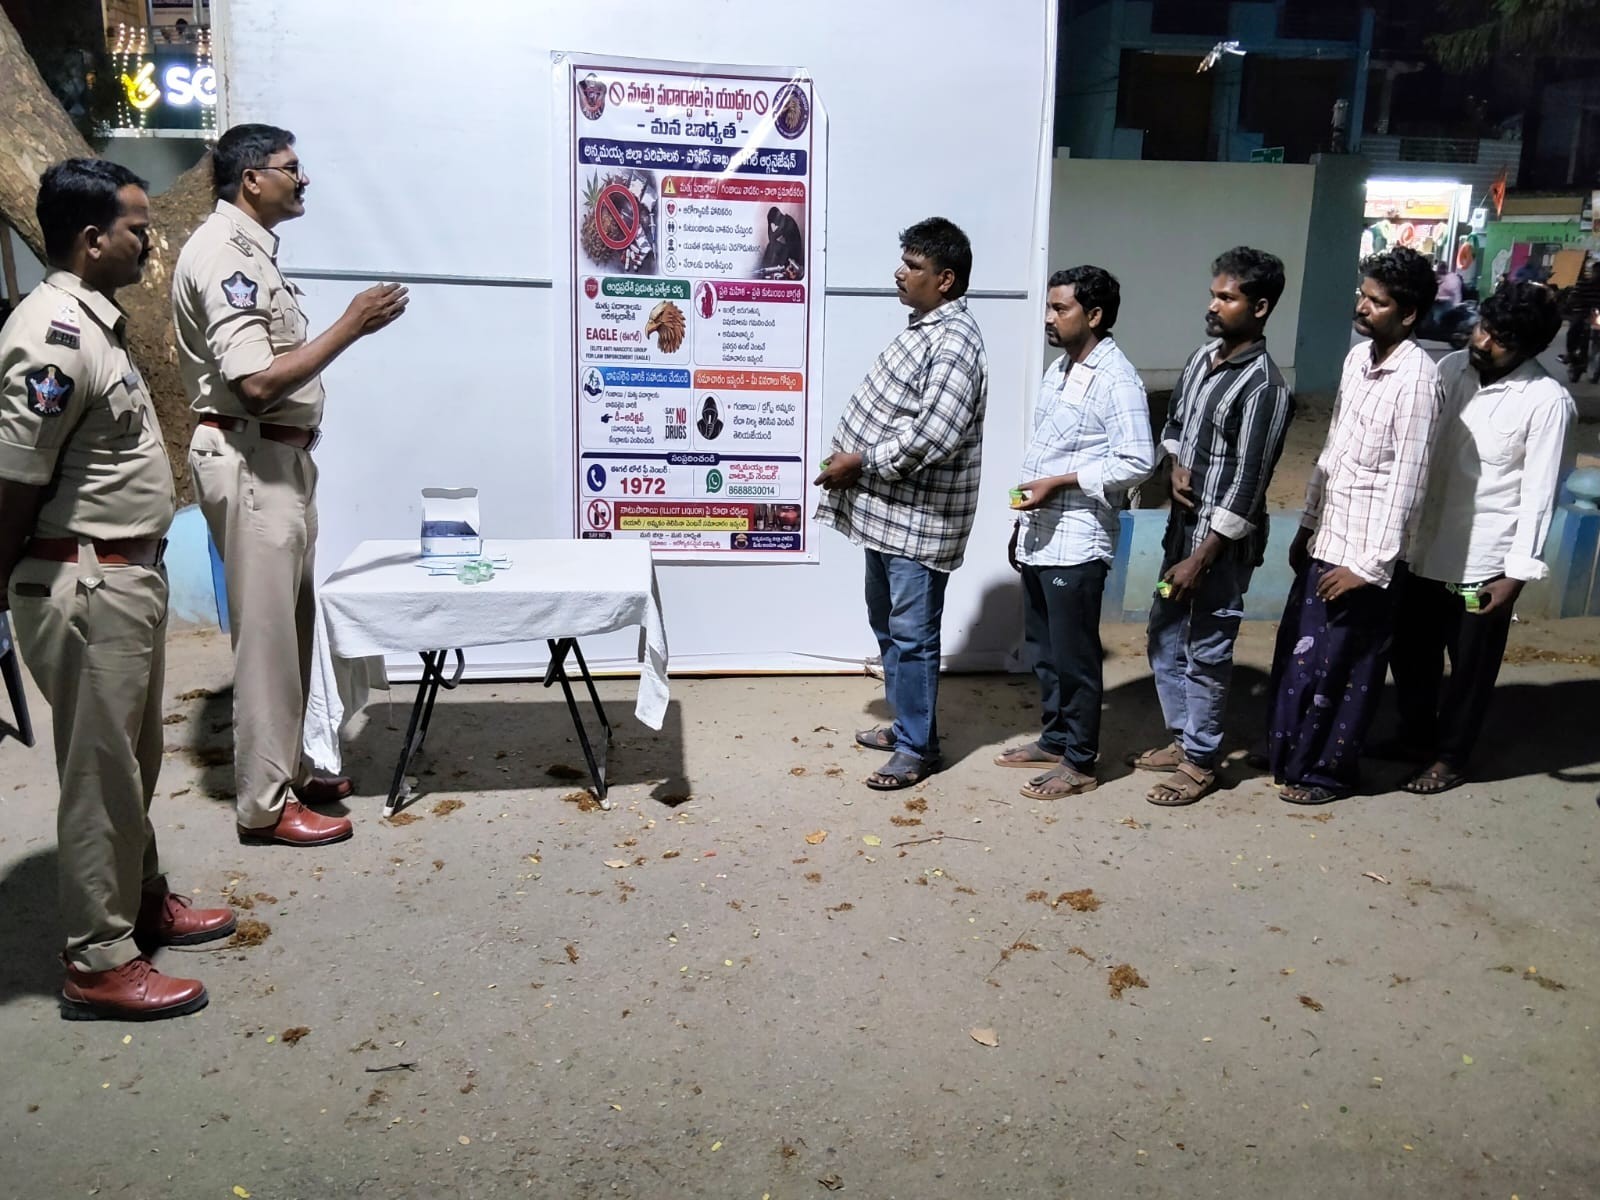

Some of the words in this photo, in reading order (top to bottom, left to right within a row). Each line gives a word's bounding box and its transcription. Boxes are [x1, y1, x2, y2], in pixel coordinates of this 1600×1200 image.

[627, 81, 655, 113] మత్తు
[651, 118, 682, 137] మన
[685, 120, 737, 144] బాధ్యత
[584, 144, 624, 165] అన్నమయ్య
[625, 148, 642, 165] జిల్లా
[643, 147, 680, 163] పరిపాలన
[686, 148, 711, 164] పోలీస్
[586, 327, 618, 342] EAGLE
[33, 402, 62, 414] POLICE
[665, 407, 675, 415] SAY
[676, 407, 687, 425] NO
[665, 415, 674, 424] TO
[665, 425, 687, 440] DRUGS
[671, 453, 716, 465] సంప్రదించండి
[611, 465, 629, 473] ఈగల్
[729, 464, 763, 474] అన్నమయ్య
[620, 477, 666, 495] 1972
[728, 485, 775, 496] 8688830014
[681, 507, 705, 517] LIQUOR)
